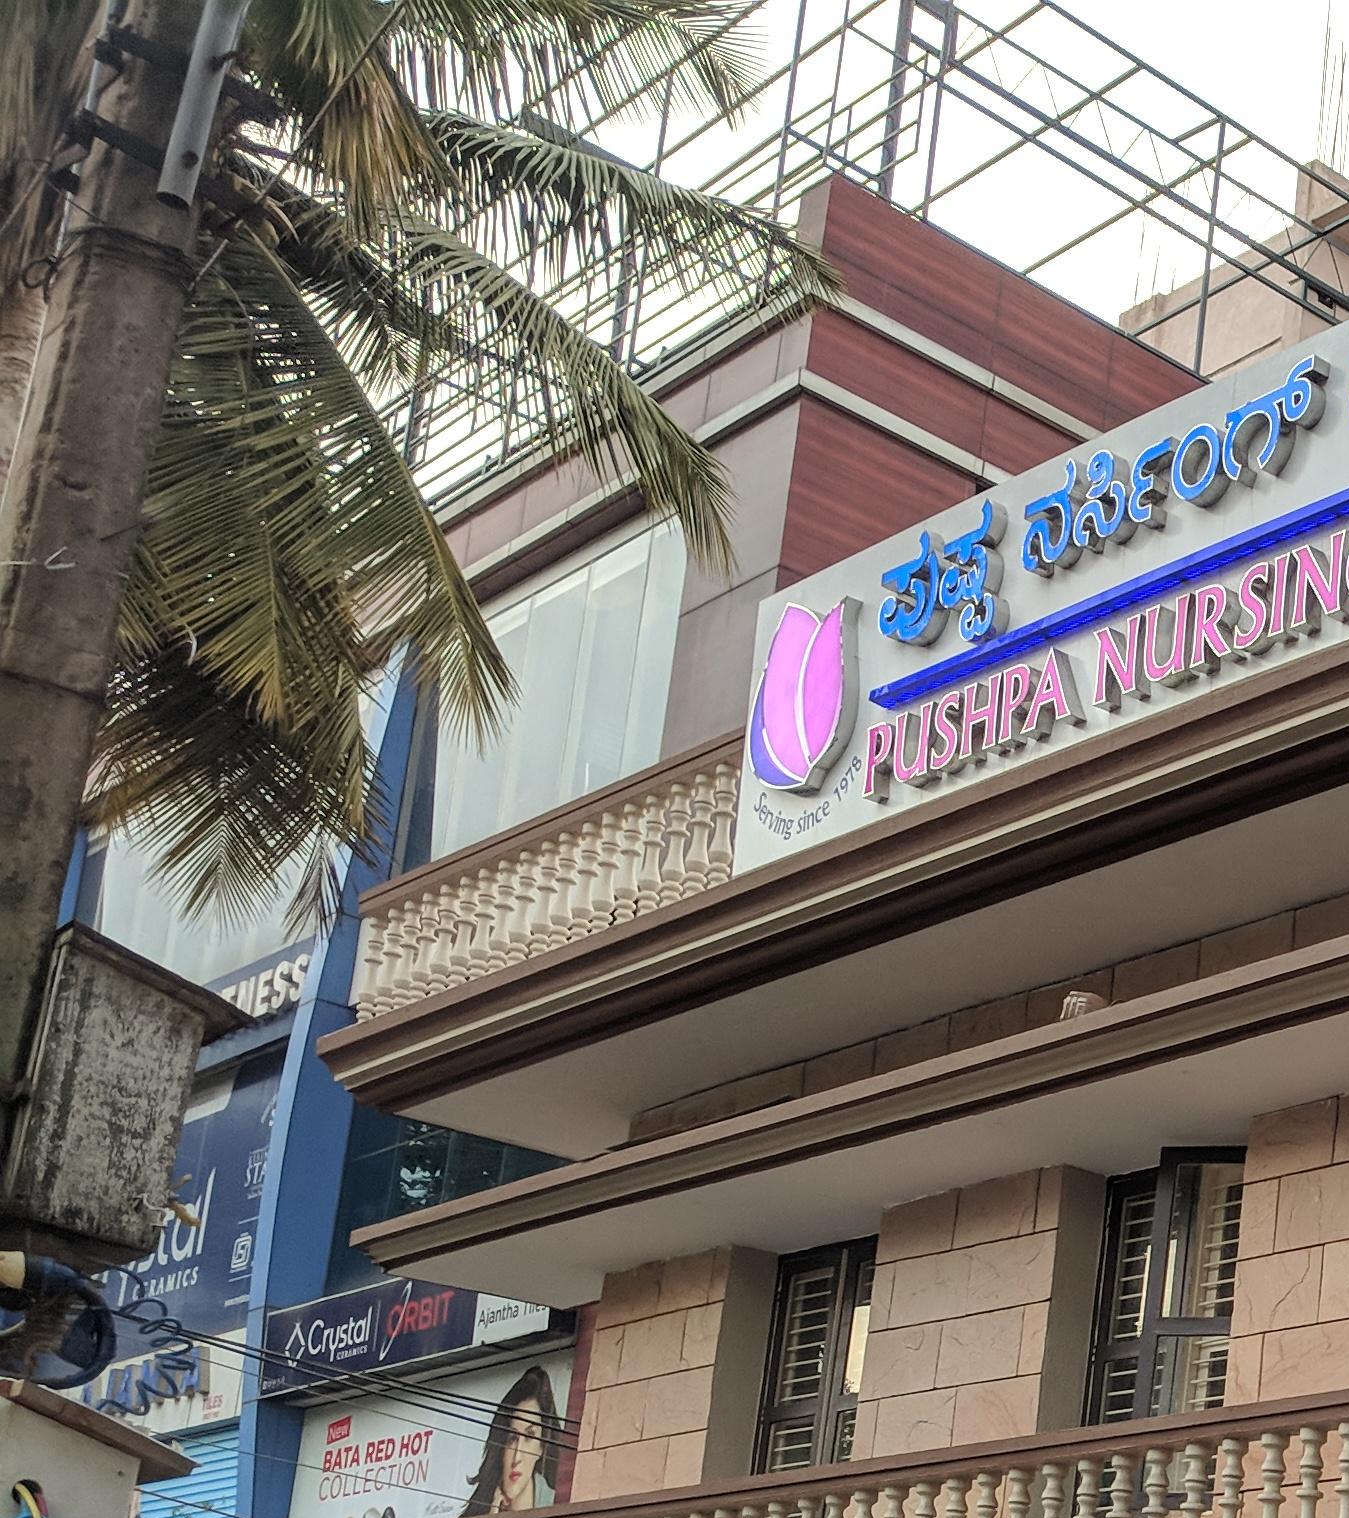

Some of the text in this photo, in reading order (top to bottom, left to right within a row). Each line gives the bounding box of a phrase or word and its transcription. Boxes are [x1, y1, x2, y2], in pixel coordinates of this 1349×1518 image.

[879, 499, 997, 643] ಪುಷ್ಪ
[1023, 355, 1318, 573] ನರ್ಸಿಂಗ್
[862, 647, 1070, 797] PUSHPA
[754, 755, 862, 840] Serving since 1978
[221, 953, 311, 1018] NESS
[132, 1266, 199, 1301] CRAMICS
[308, 1306, 373, 1362] Crystal
[386, 1290, 456, 1339] ORBIT
[478, 1303, 519, 1328] Ajantha
[322, 1430, 433, 1472] BATA RED HOT
[319, 1459, 430, 1500] COLLECTION
